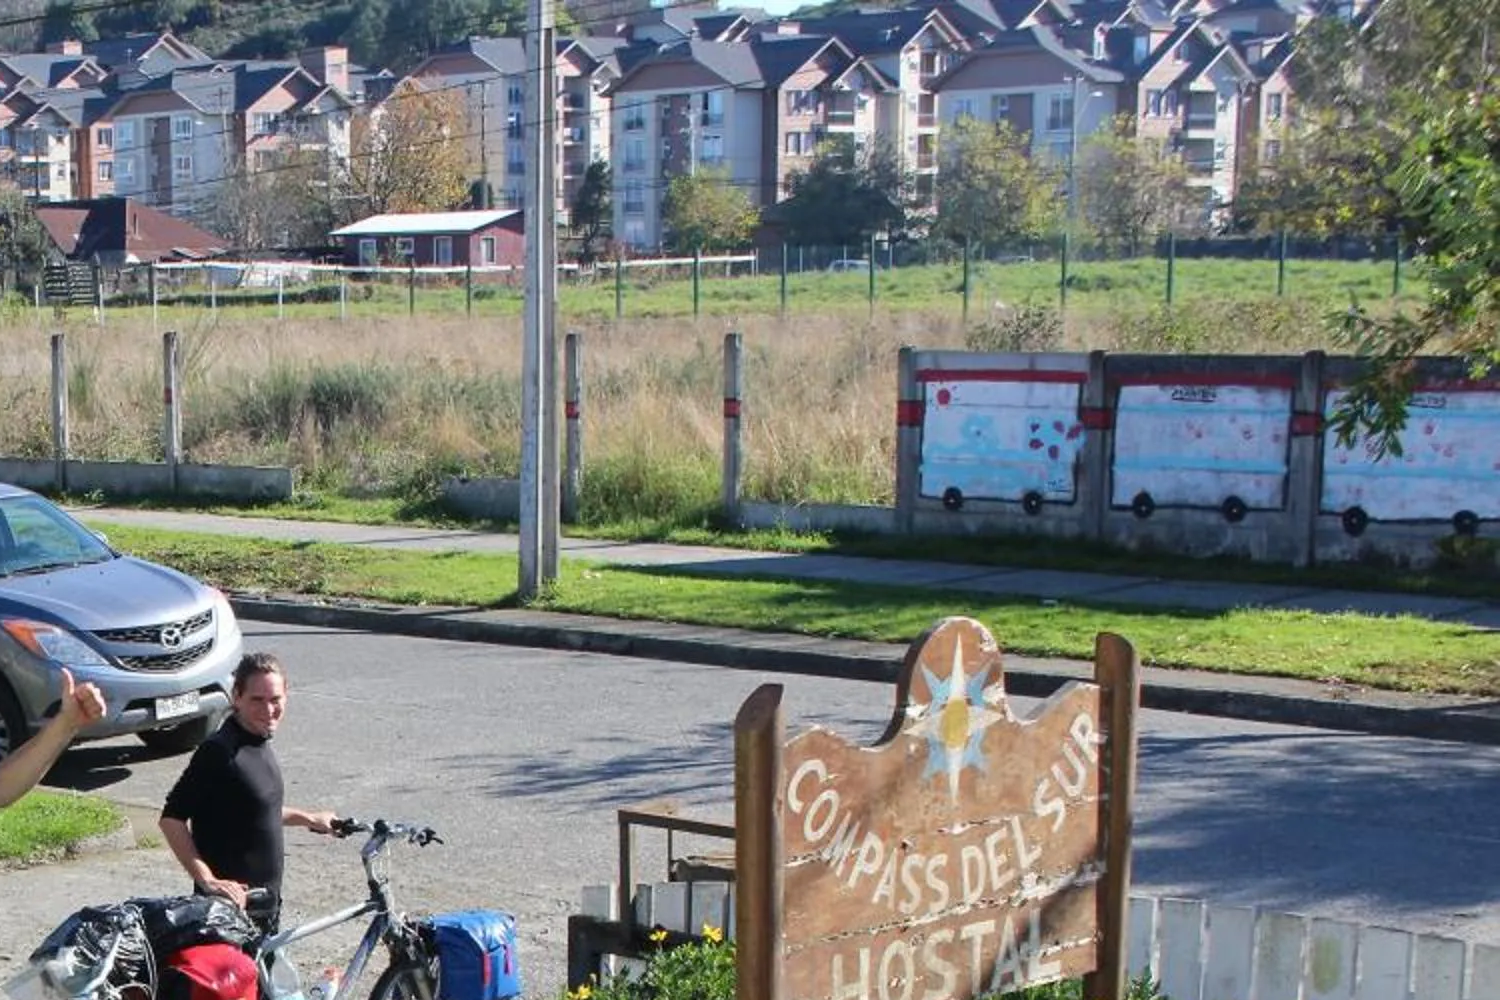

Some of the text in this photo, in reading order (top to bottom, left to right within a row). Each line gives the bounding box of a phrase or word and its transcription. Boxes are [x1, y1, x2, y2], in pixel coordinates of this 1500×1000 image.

[788, 712, 1107, 915] COMPASS DEL SUR
